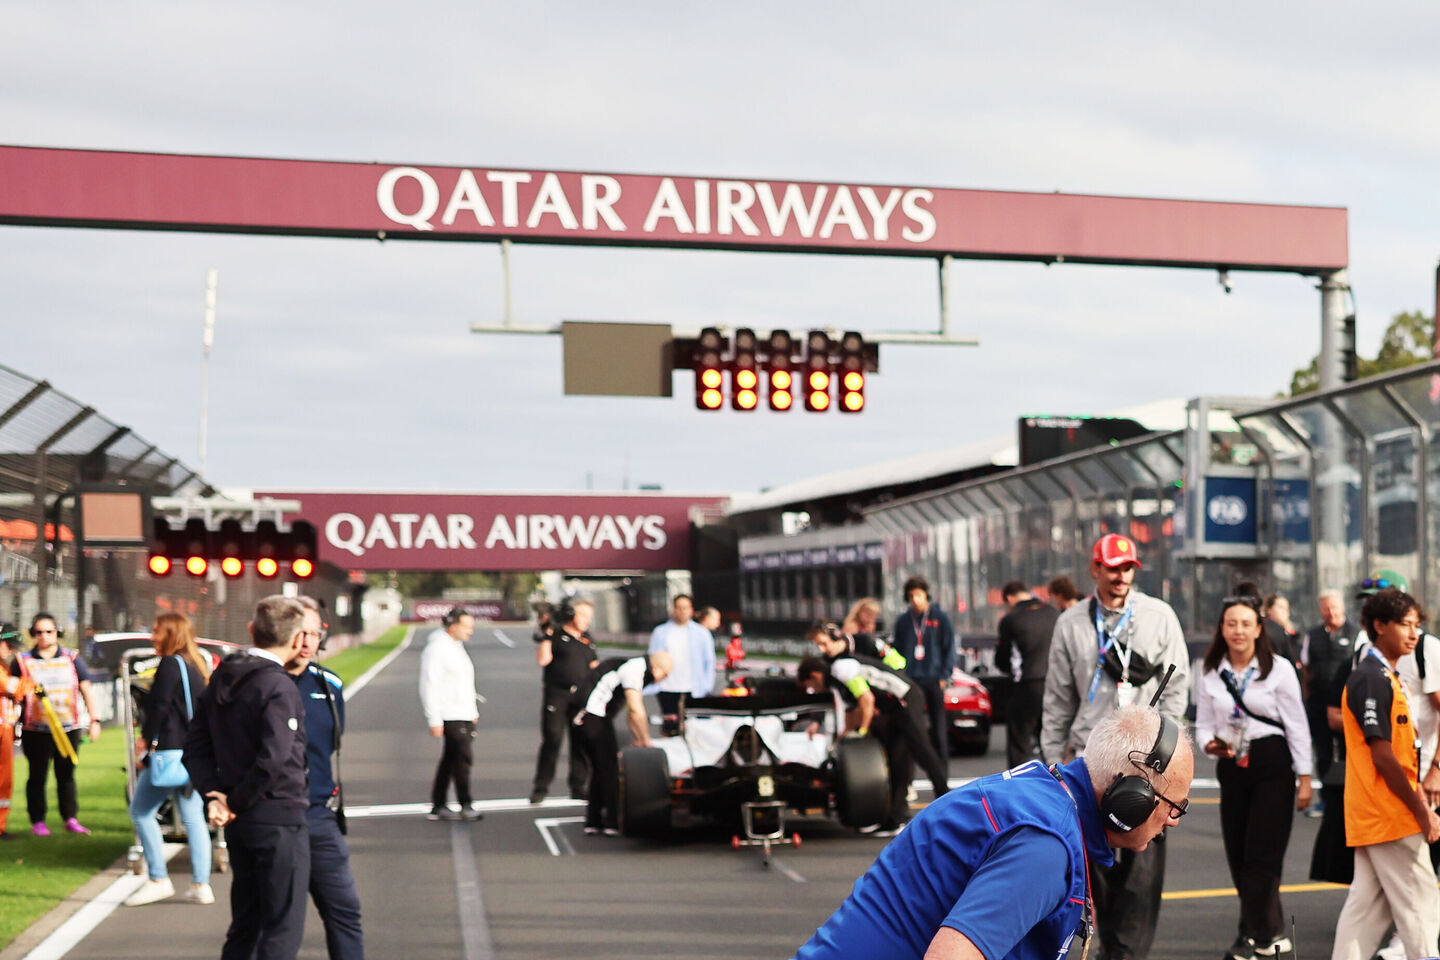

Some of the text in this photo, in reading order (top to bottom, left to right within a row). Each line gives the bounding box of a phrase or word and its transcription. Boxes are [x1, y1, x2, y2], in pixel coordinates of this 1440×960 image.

[376, 166, 938, 243] QATAR AIRWAYS
[325, 512, 668, 556] QATAR AIRWAYS
